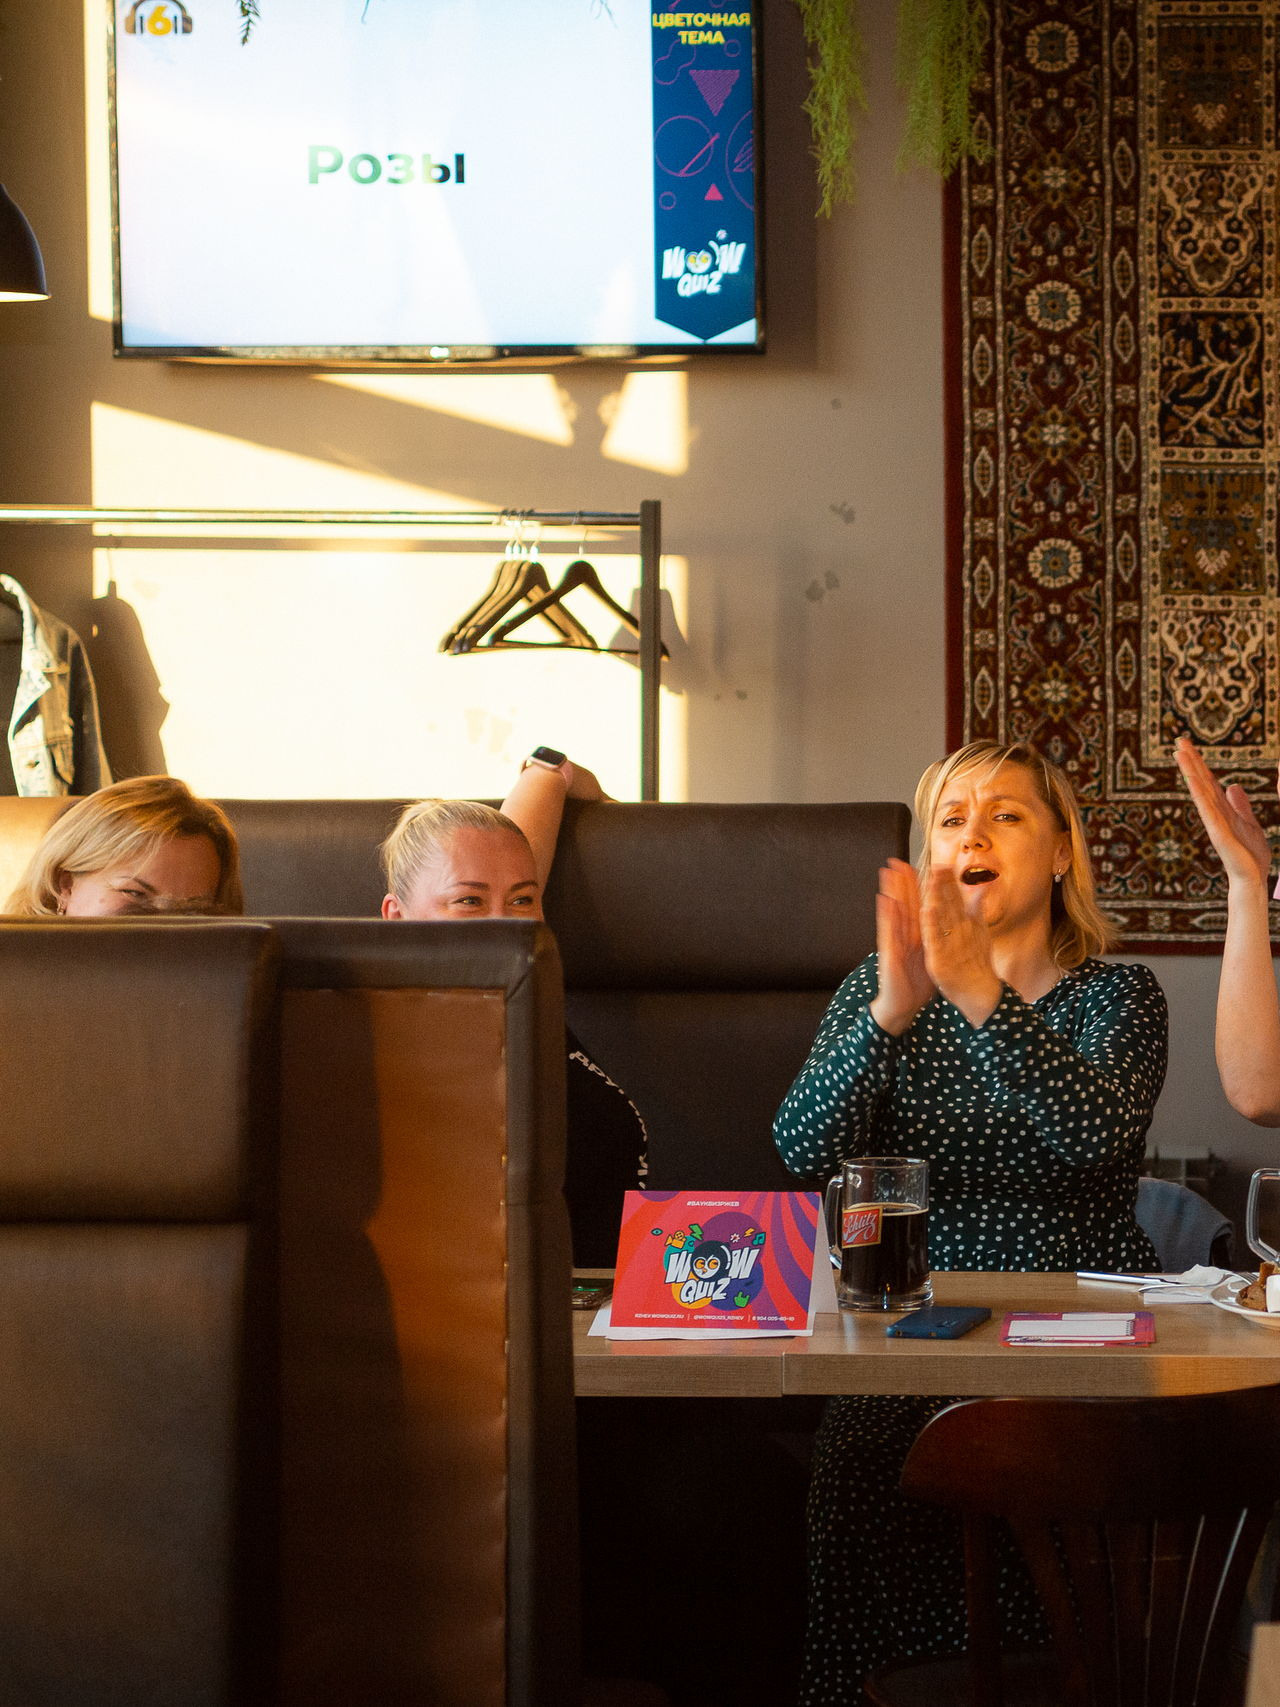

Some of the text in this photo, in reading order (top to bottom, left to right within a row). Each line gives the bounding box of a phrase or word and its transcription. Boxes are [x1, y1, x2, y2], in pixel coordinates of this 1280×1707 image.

[652, 12, 751, 29] ЦВЕТОЧНАЯ
[677, 30, 725, 45] ТЕМА
[307, 145, 465, 184] Розы
[677, 270, 722, 298] QUIZ
[665, 1246, 760, 1284] WOW
[680, 1277, 731, 1304] QUIZ
